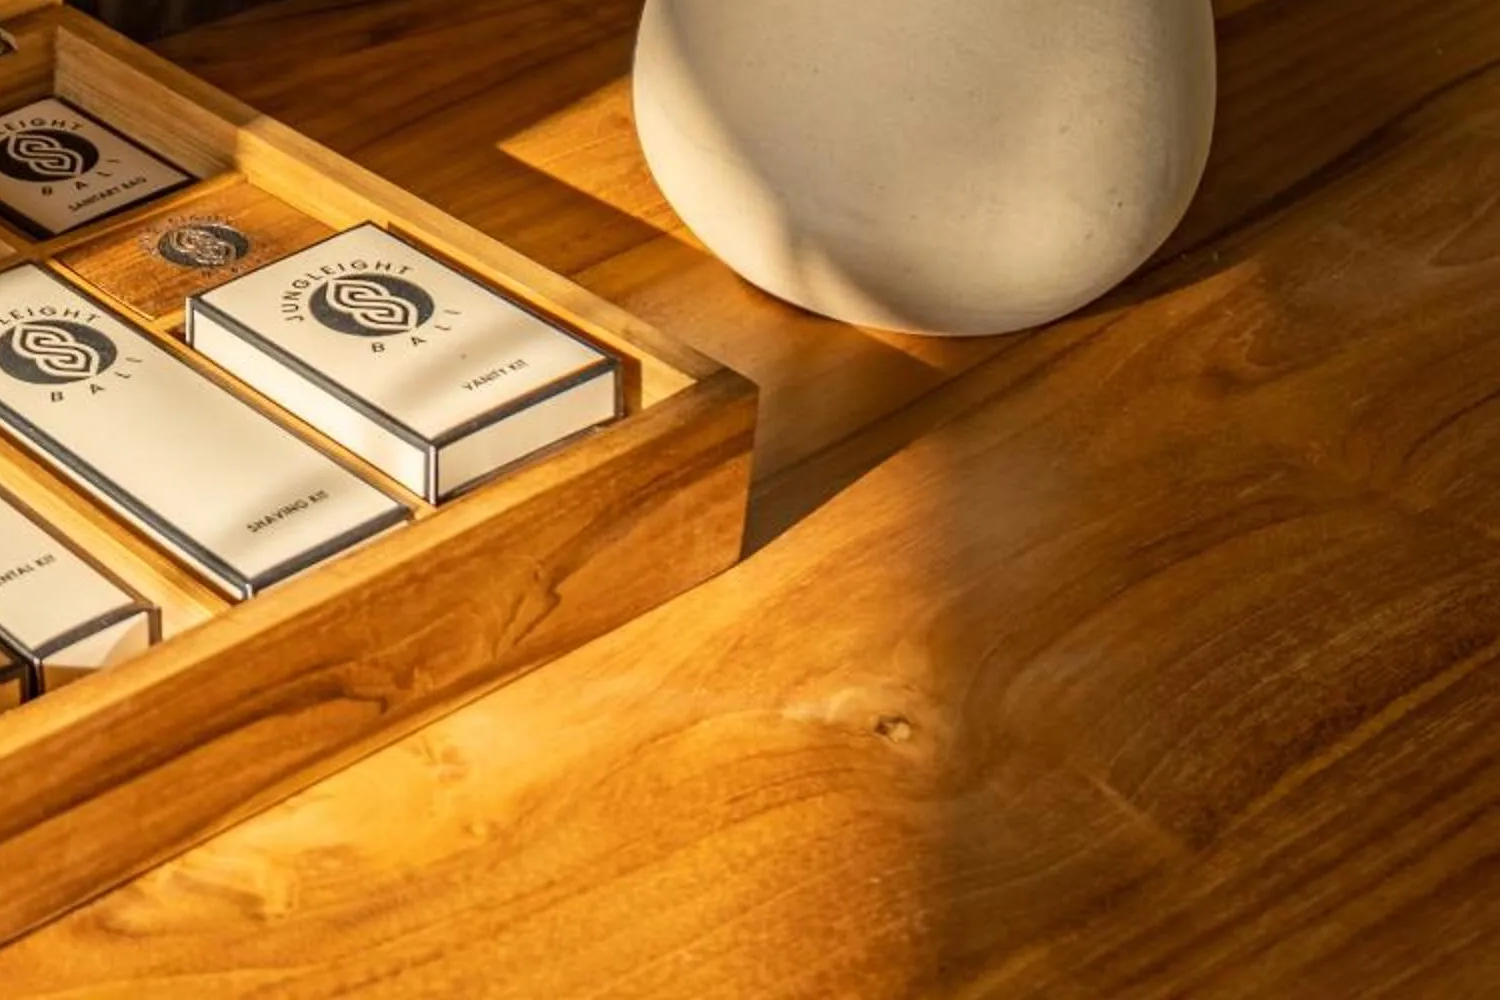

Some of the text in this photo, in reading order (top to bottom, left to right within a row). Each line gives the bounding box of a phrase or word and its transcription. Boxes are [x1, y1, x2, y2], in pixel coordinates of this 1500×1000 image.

[41, 158, 121, 196] BALI
[67, 176, 148, 213] SANITARY BAG
[280, 258, 413, 323] JUNGLEIGHT
[370, 308, 461, 354] BALI
[50, 355, 143, 403] BALI
[461, 358, 530, 392] VANITY KIT
[246, 489, 330, 534] SHAVING KIT
[34, 553, 57, 568] KIT
